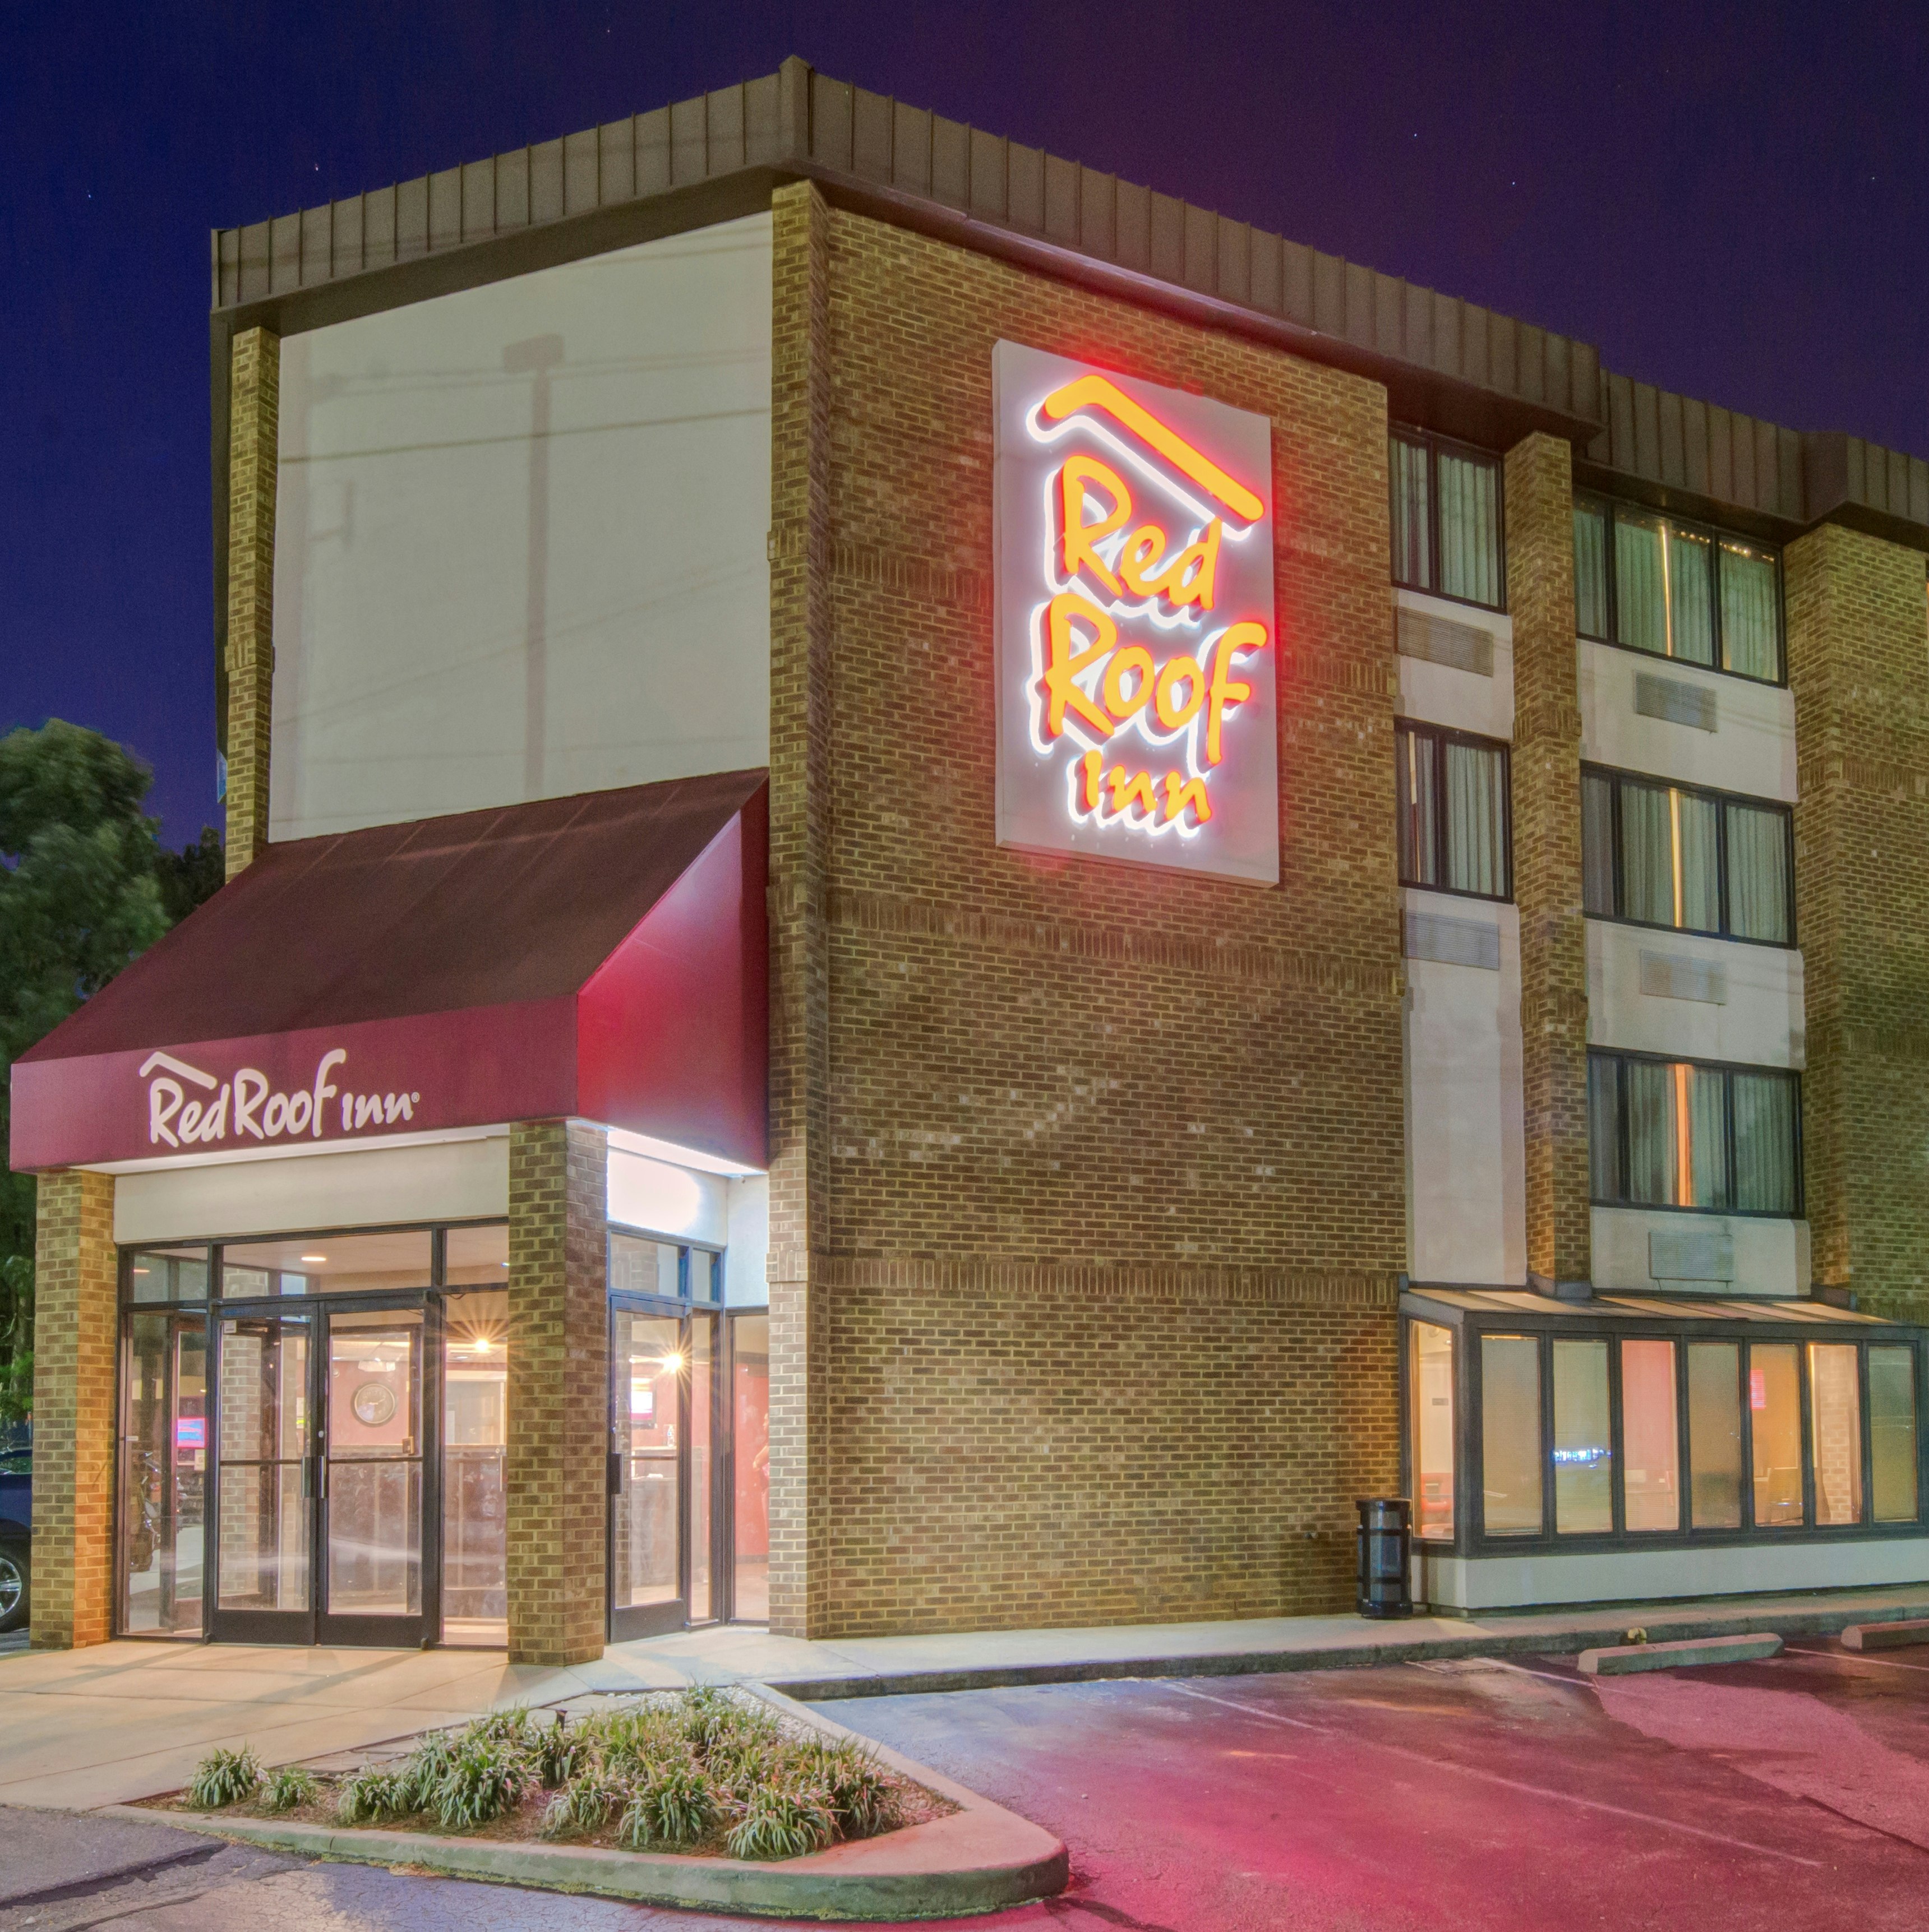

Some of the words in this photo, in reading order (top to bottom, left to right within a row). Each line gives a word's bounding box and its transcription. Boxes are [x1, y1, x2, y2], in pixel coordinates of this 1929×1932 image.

[1063, 455, 1222, 610] Red
[1045, 593, 1267, 764] Roof
[150, 1078, 230, 1148] Red
[234, 1048, 345, 1139] Roof
